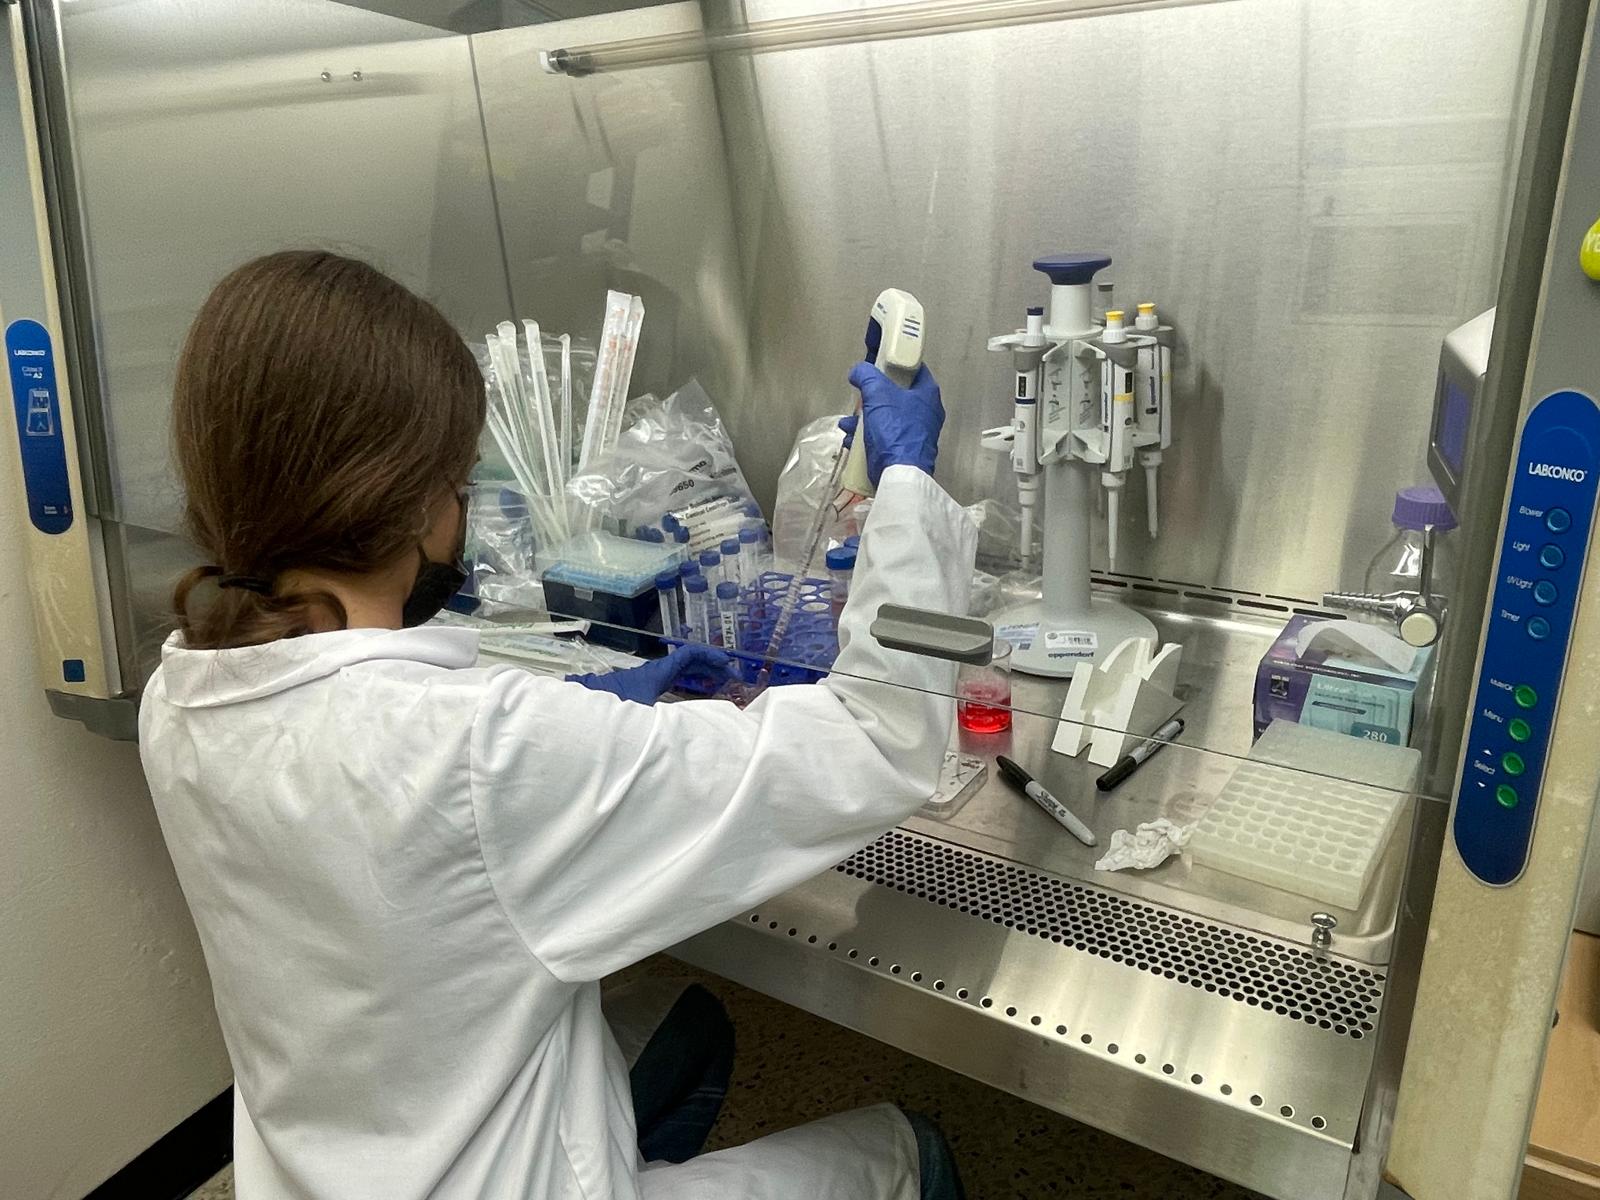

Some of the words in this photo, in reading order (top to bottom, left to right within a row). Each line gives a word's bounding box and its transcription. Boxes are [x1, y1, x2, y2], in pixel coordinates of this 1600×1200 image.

[1529, 462, 1585, 483] LABCONCO
[1512, 541, 1531, 552] Light
[1048, 651, 1095, 659] eppendorf
[1483, 708, 1504, 723] Menu
[1363, 729, 1388, 742] 280
